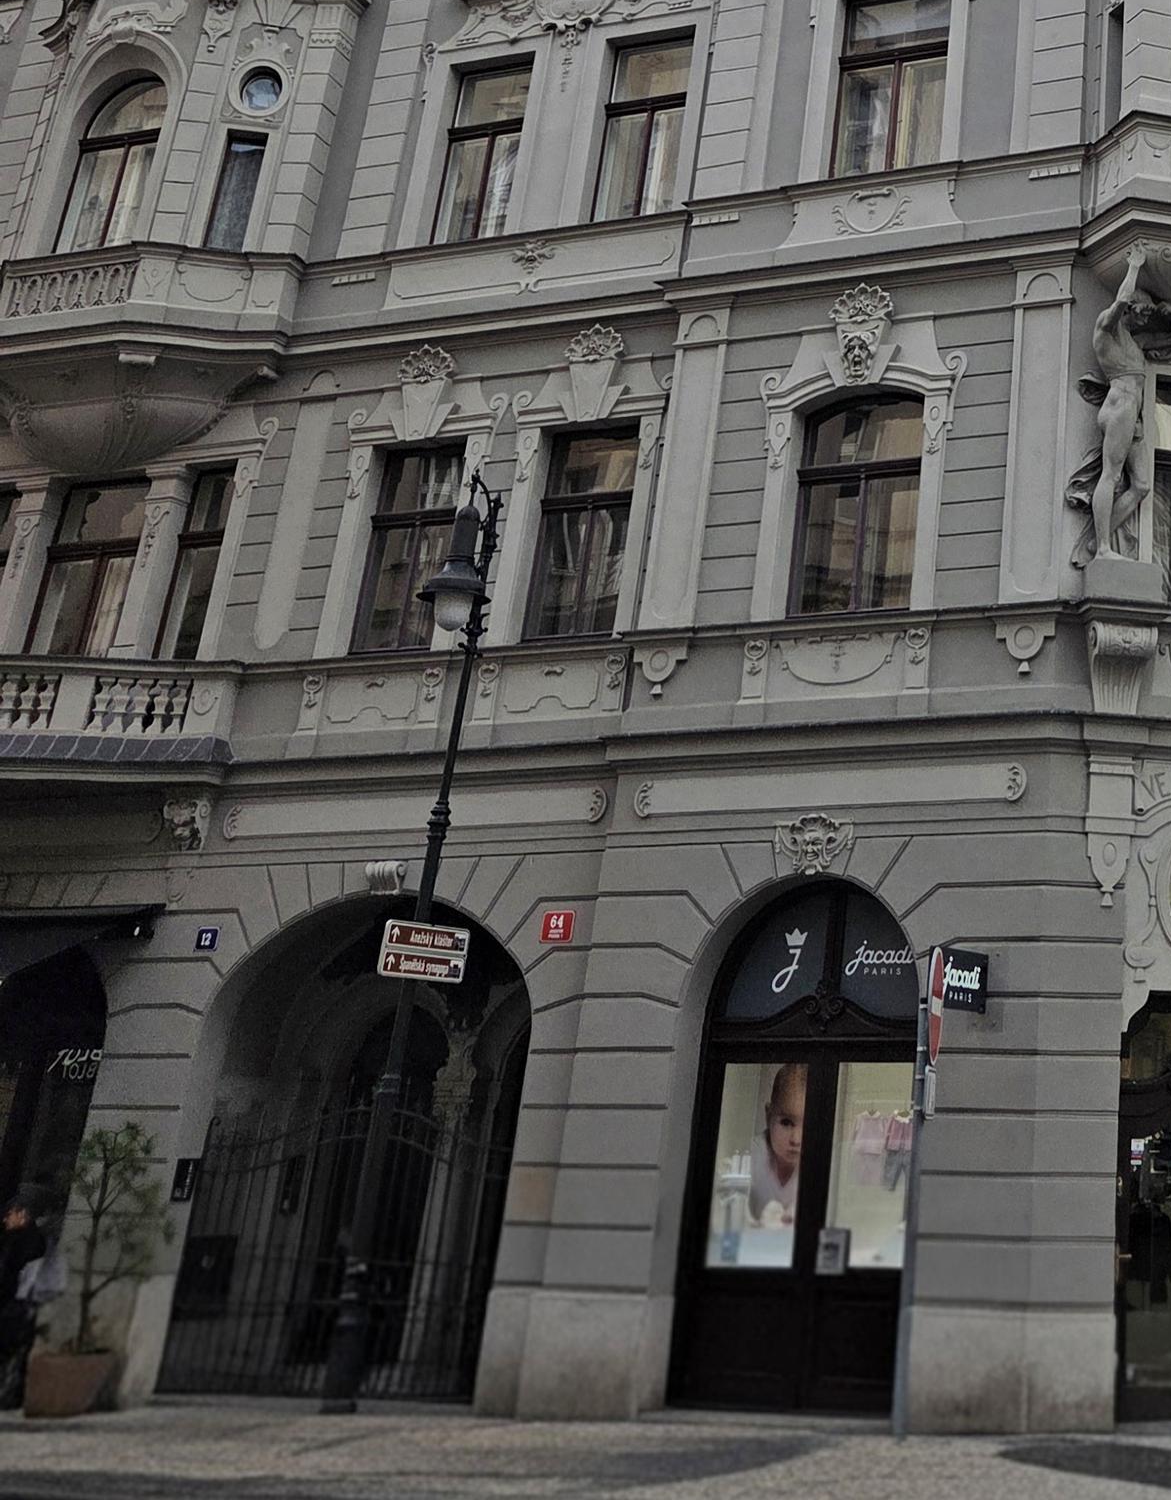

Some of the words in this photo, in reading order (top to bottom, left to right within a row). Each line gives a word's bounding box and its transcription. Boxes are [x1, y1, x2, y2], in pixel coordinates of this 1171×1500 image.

[1140, 771, 1171, 801] VE
[550, 915, 565, 929] 64
[200, 932, 212, 946] 12
[863, 966, 902, 976] PARIS
[949, 990, 972, 1003] PARIS
